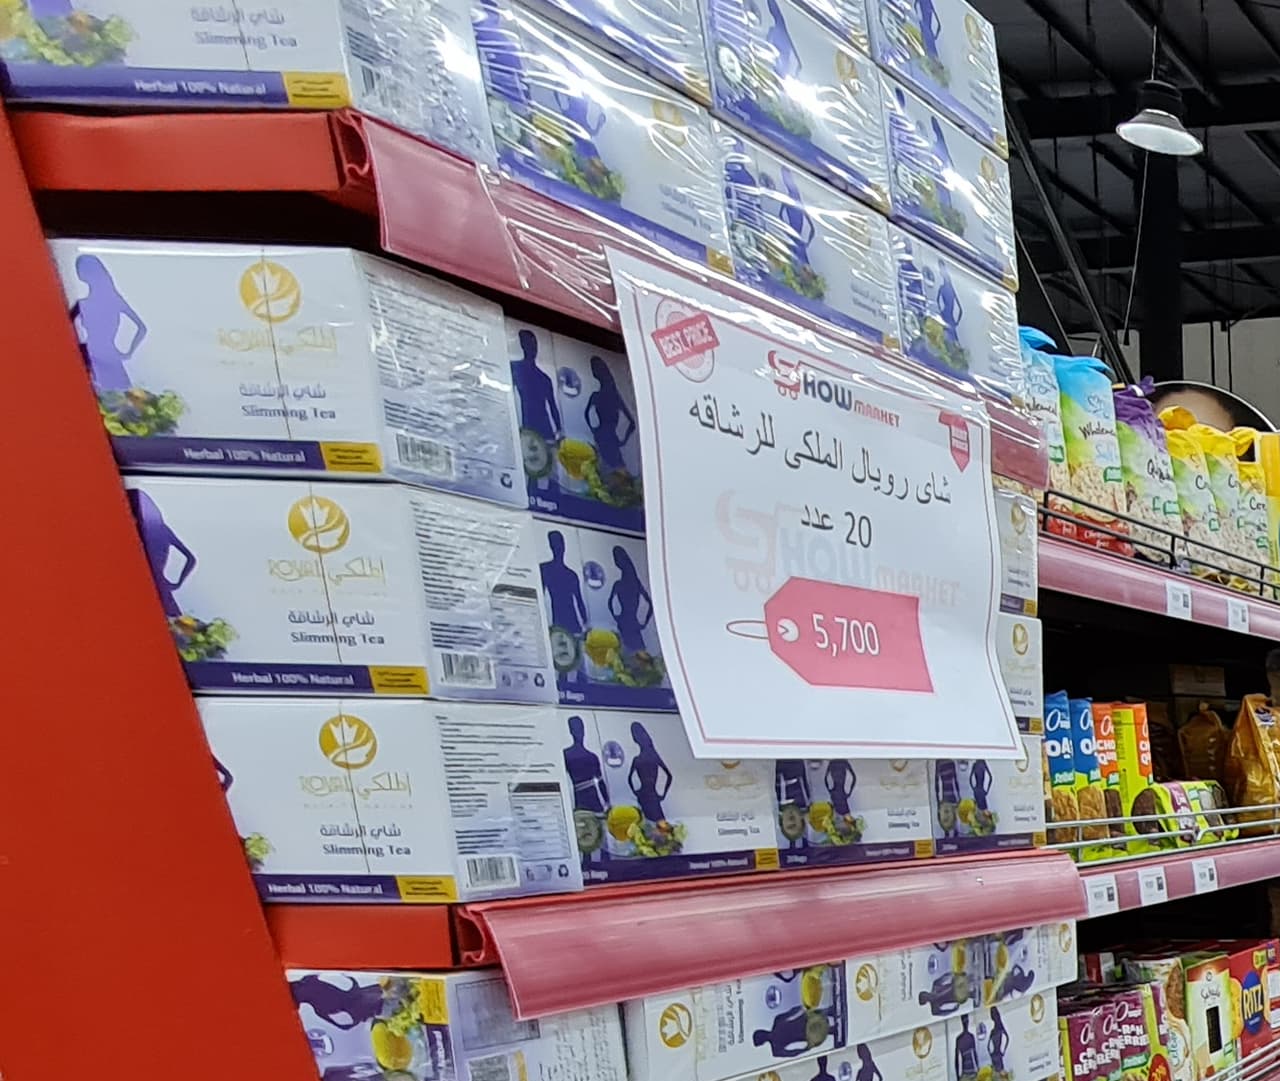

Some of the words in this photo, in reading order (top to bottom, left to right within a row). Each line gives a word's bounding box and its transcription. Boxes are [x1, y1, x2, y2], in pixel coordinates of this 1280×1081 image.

[241, 404, 306, 422] Slimming
[311, 407, 338, 421] Tea
[853, 400, 900, 428] MARKET
[183, 447, 223, 462] Herbal
[226, 448, 257, 463] 100%
[260, 449, 306, 465] Natural
[800, 504, 834, 532] عدد
[845, 511, 873, 549] 20
[290, 631, 357, 648] Slimming
[360, 632, 386, 645] Tea
[811, 613, 881, 660] 5,700
[231, 671, 272, 685] Herbal
[274, 671, 308, 685] 100%
[310, 672, 354, 686] Natural
[322, 843, 384, 858] Slimming
[387, 844, 411, 857] Tea
[267, 882, 306, 896] Herbal
[308, 882, 339, 896] 100%
[341, 884, 384, 896] Natural
[1243, 985, 1264, 1014] RITZ
